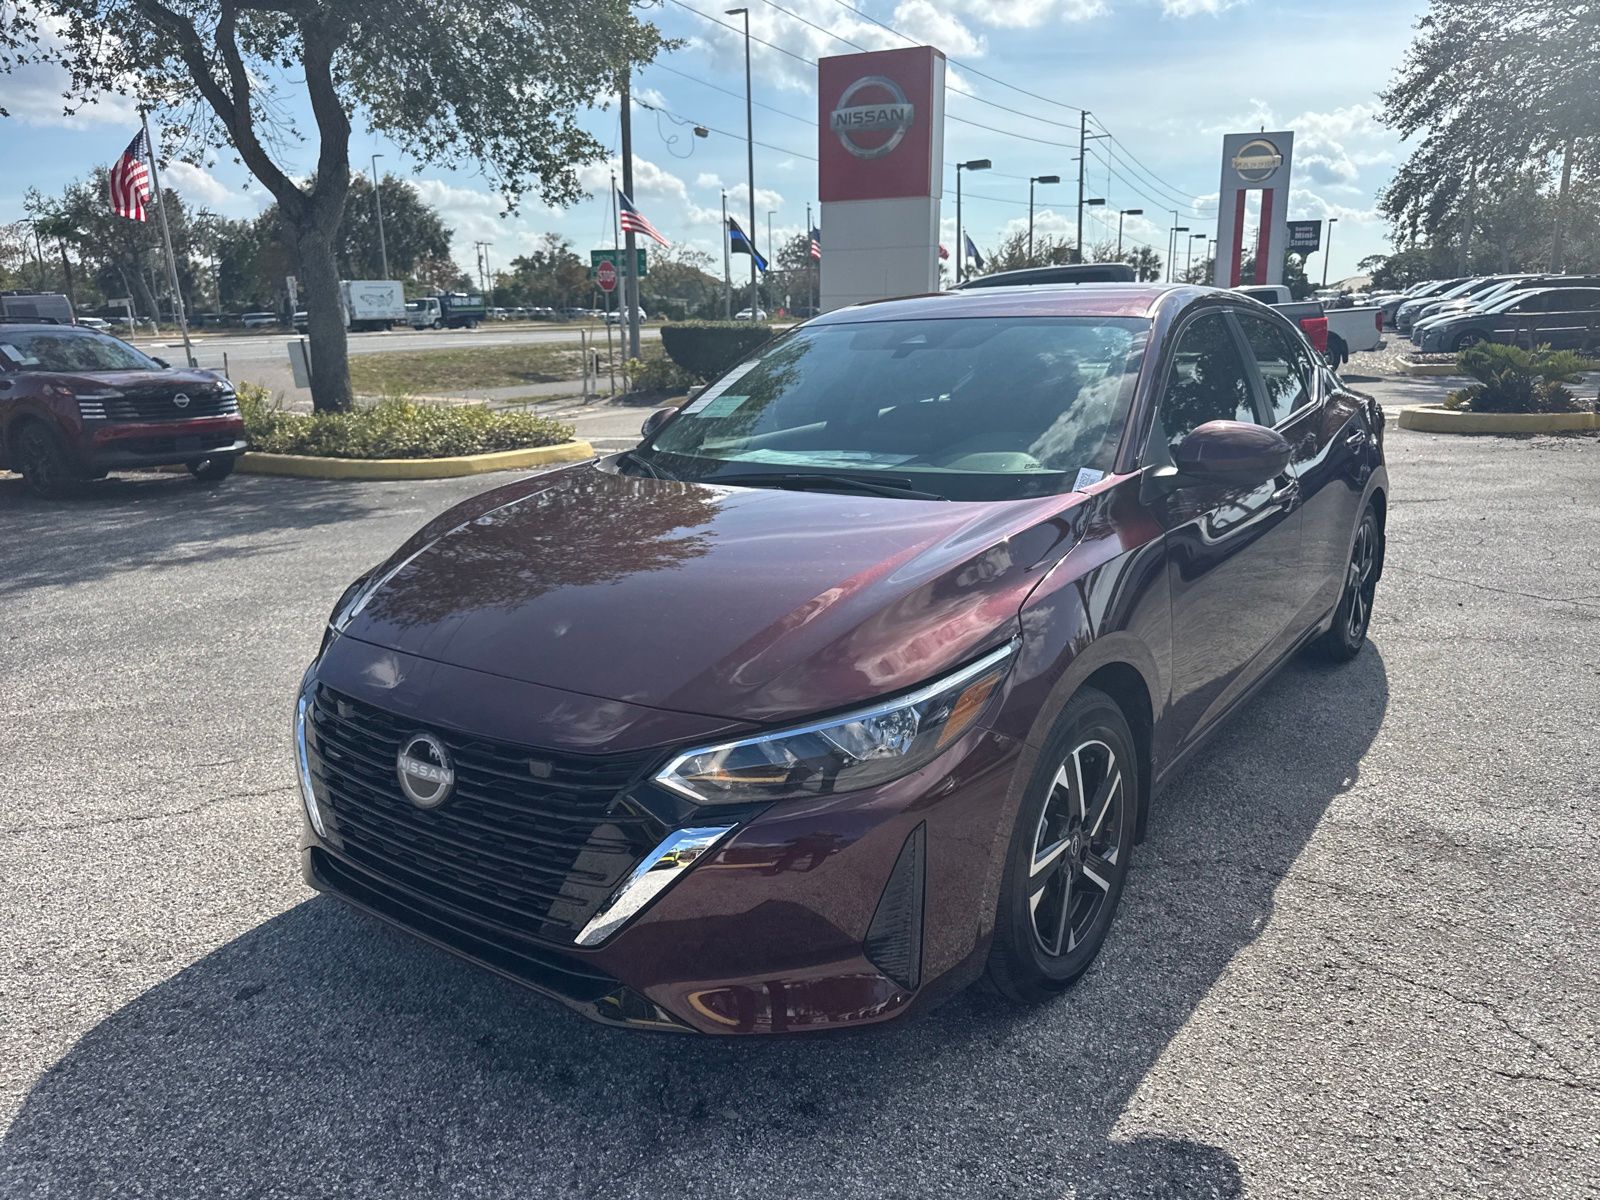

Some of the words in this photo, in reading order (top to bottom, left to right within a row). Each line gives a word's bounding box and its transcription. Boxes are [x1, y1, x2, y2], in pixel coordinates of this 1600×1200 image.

[836, 108, 905, 126] NISSAN
[1290, 239, 1318, 247] Storage
[599, 270, 616, 282] STOP
[399, 757, 451, 782] NISSAN
